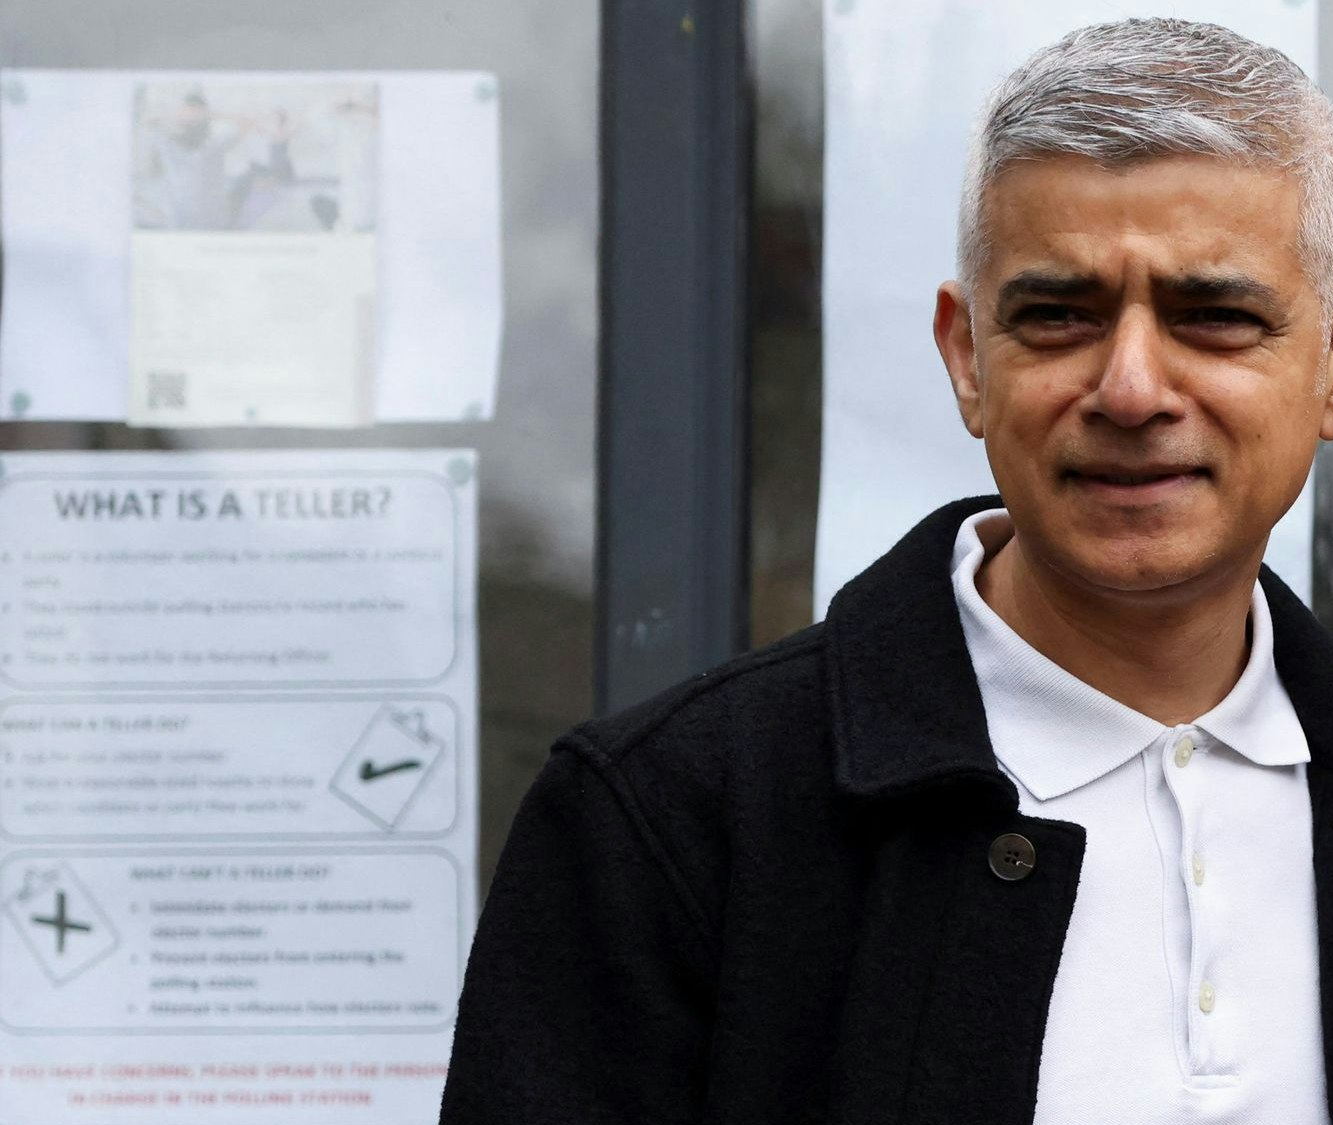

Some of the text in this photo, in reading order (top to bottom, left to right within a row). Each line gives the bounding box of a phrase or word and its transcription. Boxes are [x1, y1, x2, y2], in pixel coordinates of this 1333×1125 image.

[55, 487, 392, 521] WHAT IS A TELLER?
